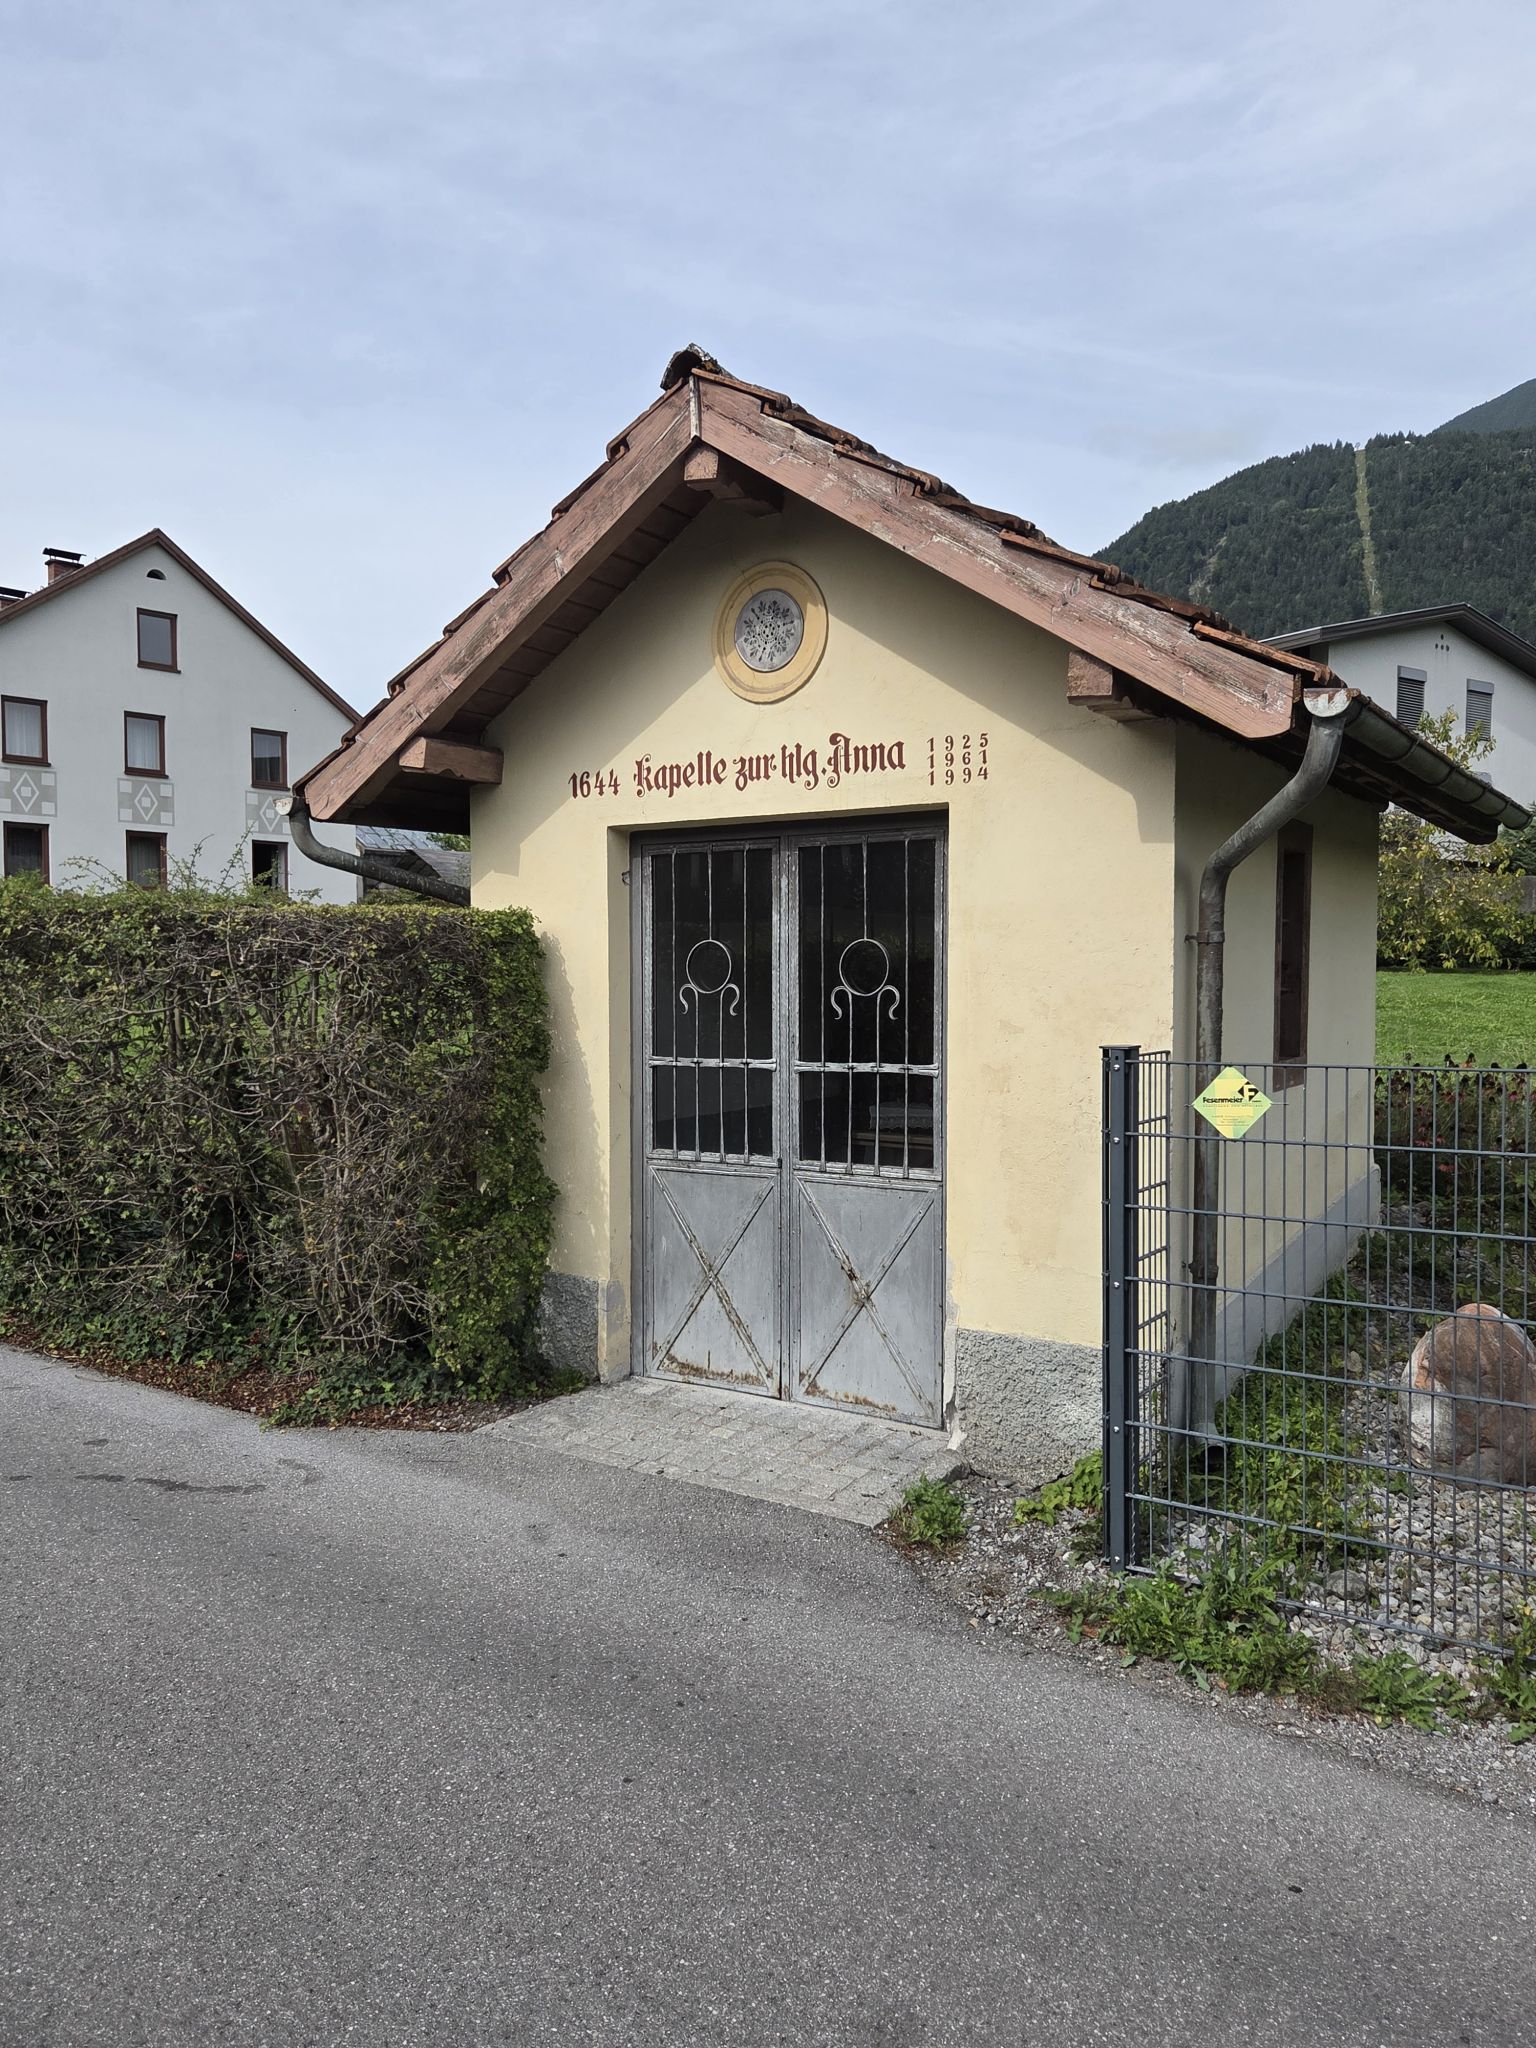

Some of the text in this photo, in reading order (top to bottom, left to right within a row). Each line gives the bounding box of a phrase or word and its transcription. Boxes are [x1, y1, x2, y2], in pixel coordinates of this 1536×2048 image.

[927, 732, 989, 752] 1925
[568, 732, 907, 799] 1644 Kapelle zur hlg. Anna
[927, 749, 989, 770] 1961
[927, 766, 989, 786] 1994
